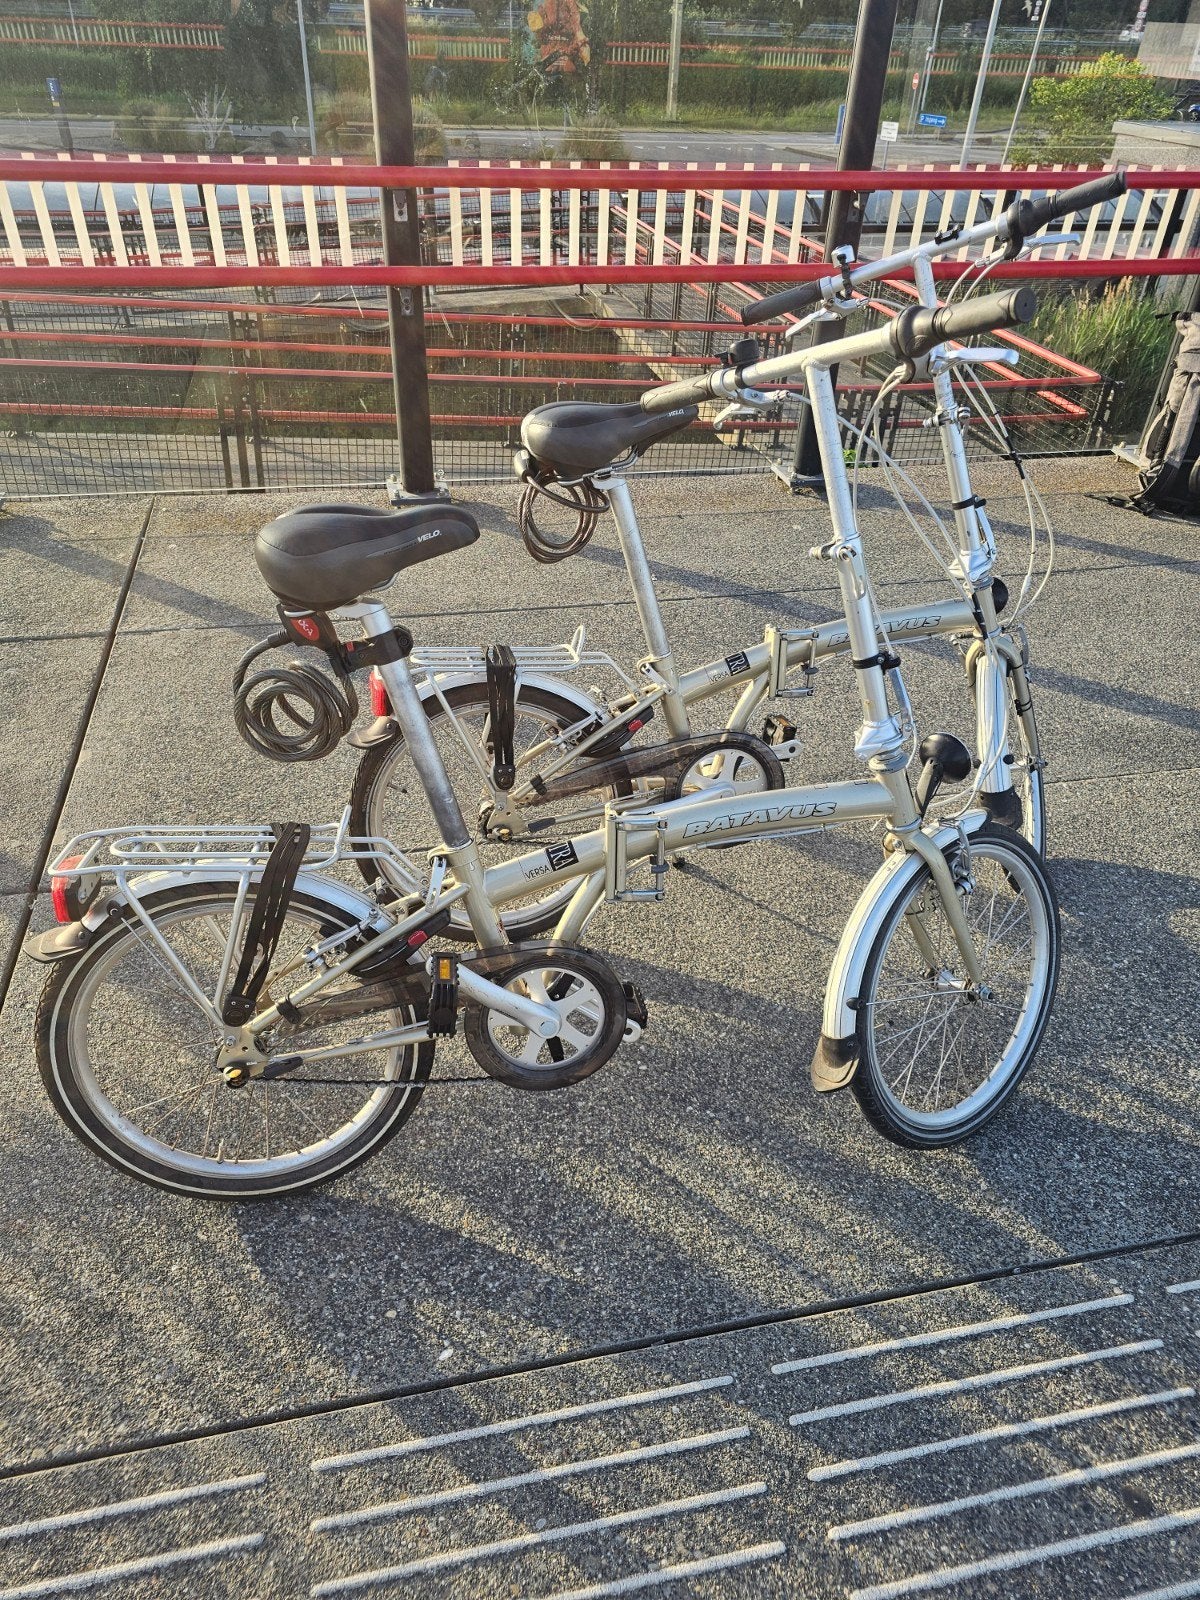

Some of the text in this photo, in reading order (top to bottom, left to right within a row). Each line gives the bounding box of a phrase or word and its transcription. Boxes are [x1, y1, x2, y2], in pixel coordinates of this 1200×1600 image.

[827, 615, 942, 648] BAVUS
[682, 801, 838, 839] BATAVUS
[524, 864, 551, 880] VERSA
